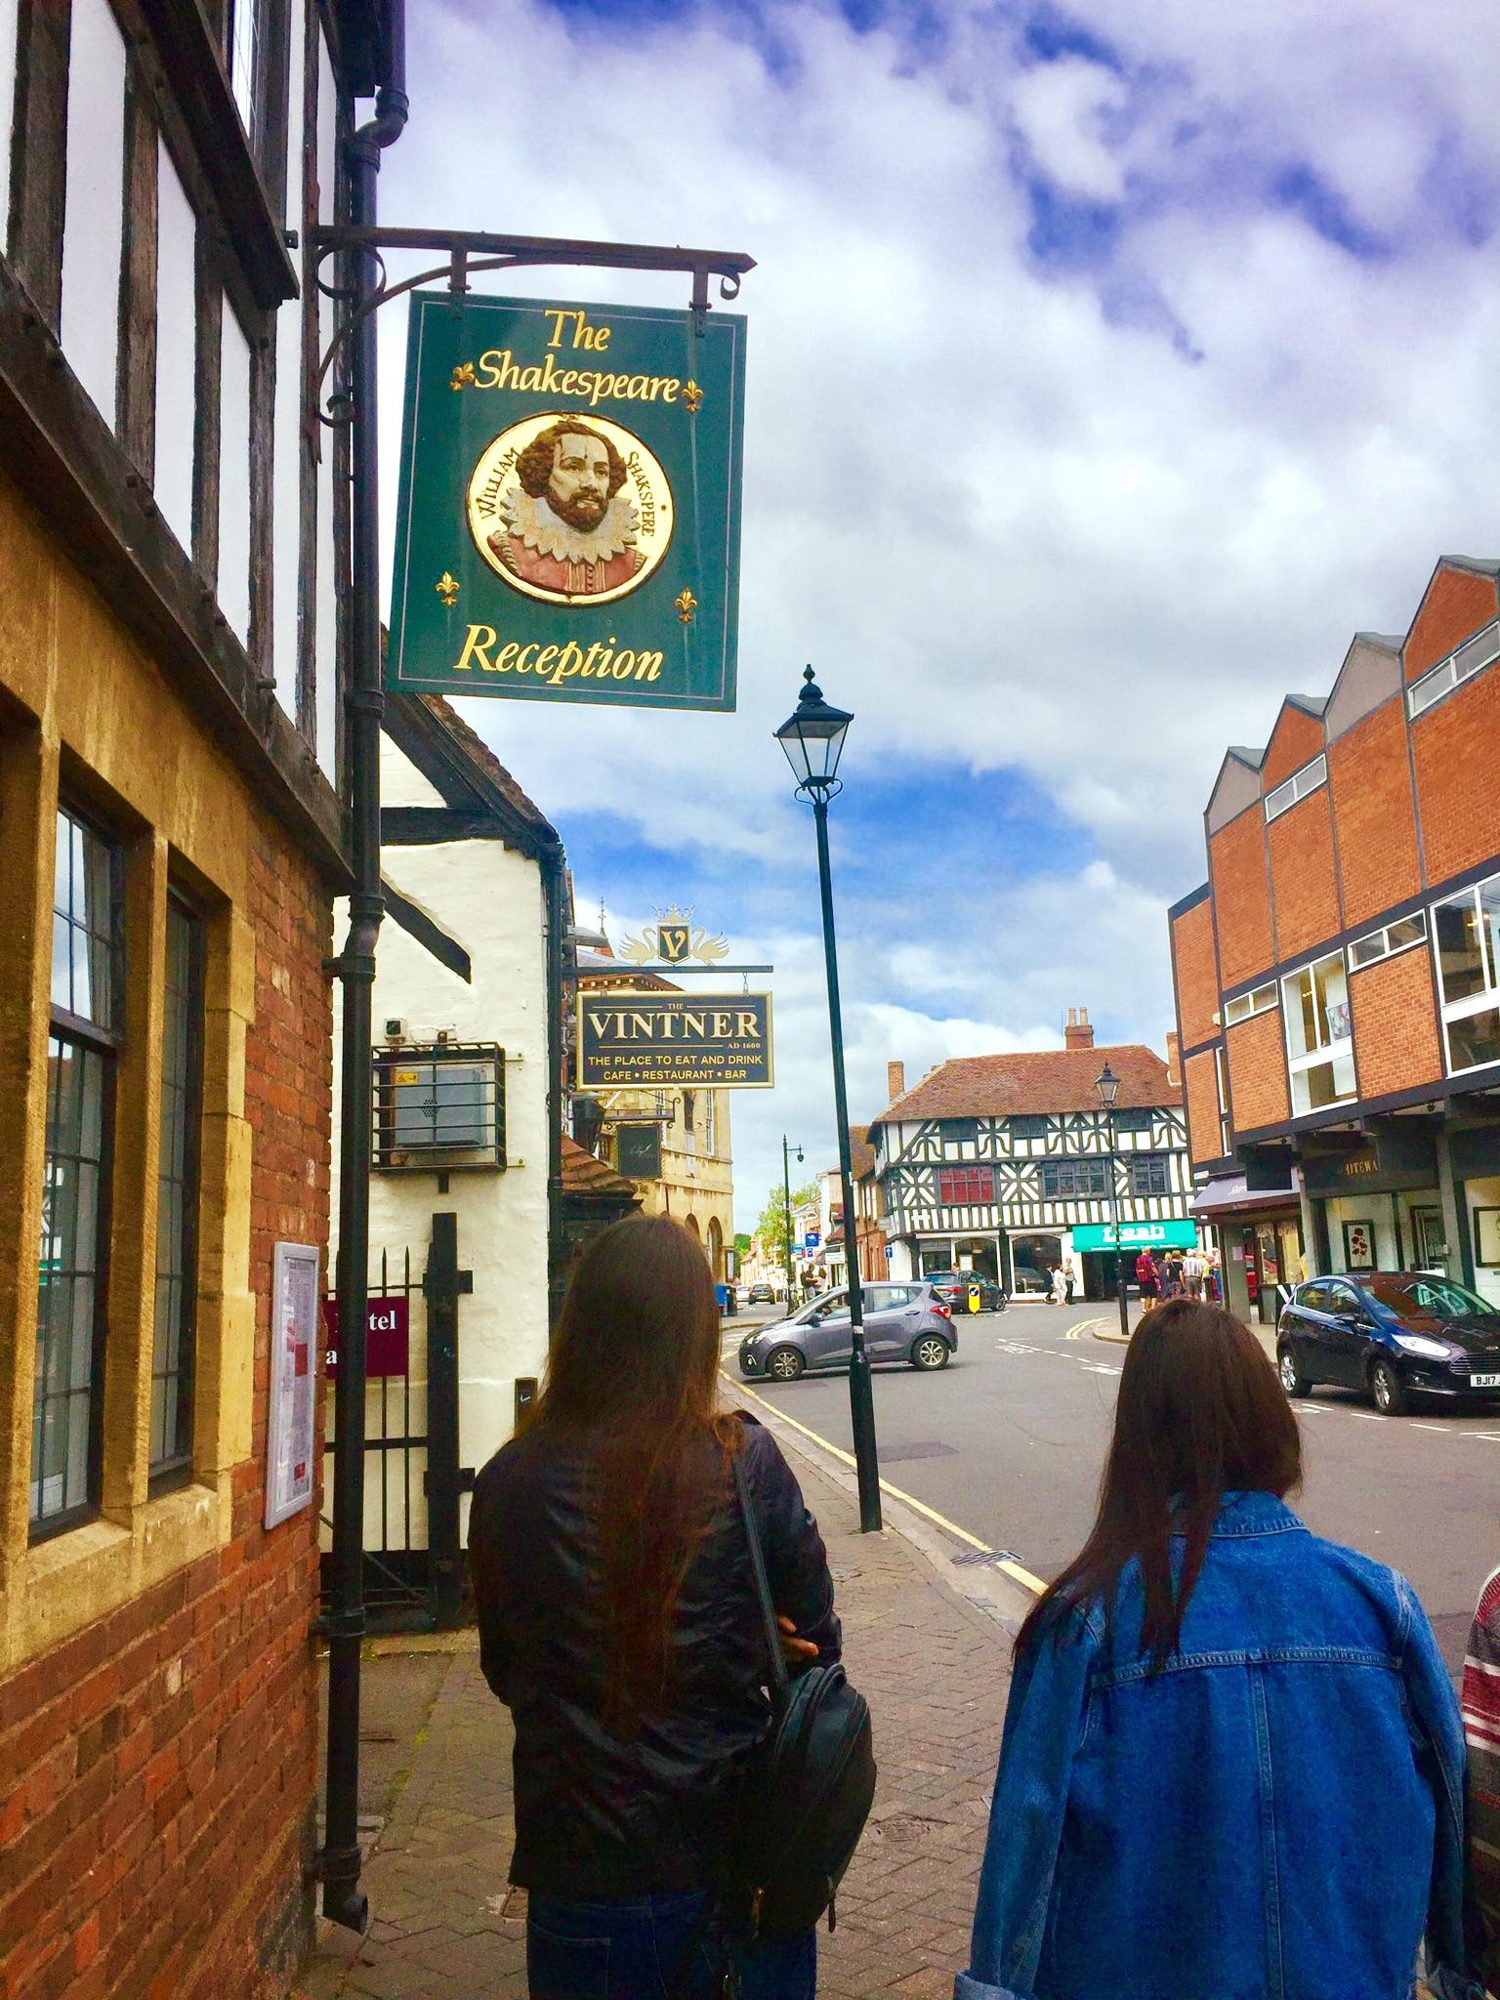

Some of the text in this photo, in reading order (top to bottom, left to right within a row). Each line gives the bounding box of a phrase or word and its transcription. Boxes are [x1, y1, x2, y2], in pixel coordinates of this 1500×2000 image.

[544, 309, 611, 351] The
[474, 350, 681, 407] Shakespeare
[475, 446, 520, 520] WILLIAM
[626, 451, 656, 538] SHAKSPERE
[453, 624, 664, 685] Reception
[660, 930, 687, 958] V
[587, 1012, 762, 1039] VINTNER
[587, 1055, 763, 1066] THE PLACE TO EAT AND DRINK
[603, 1069, 747, 1080] CAFE RESTAURANT BAR
[368, 1310, 397, 1331] tel
[1475, 1376, 1496, 1385] BJ17
